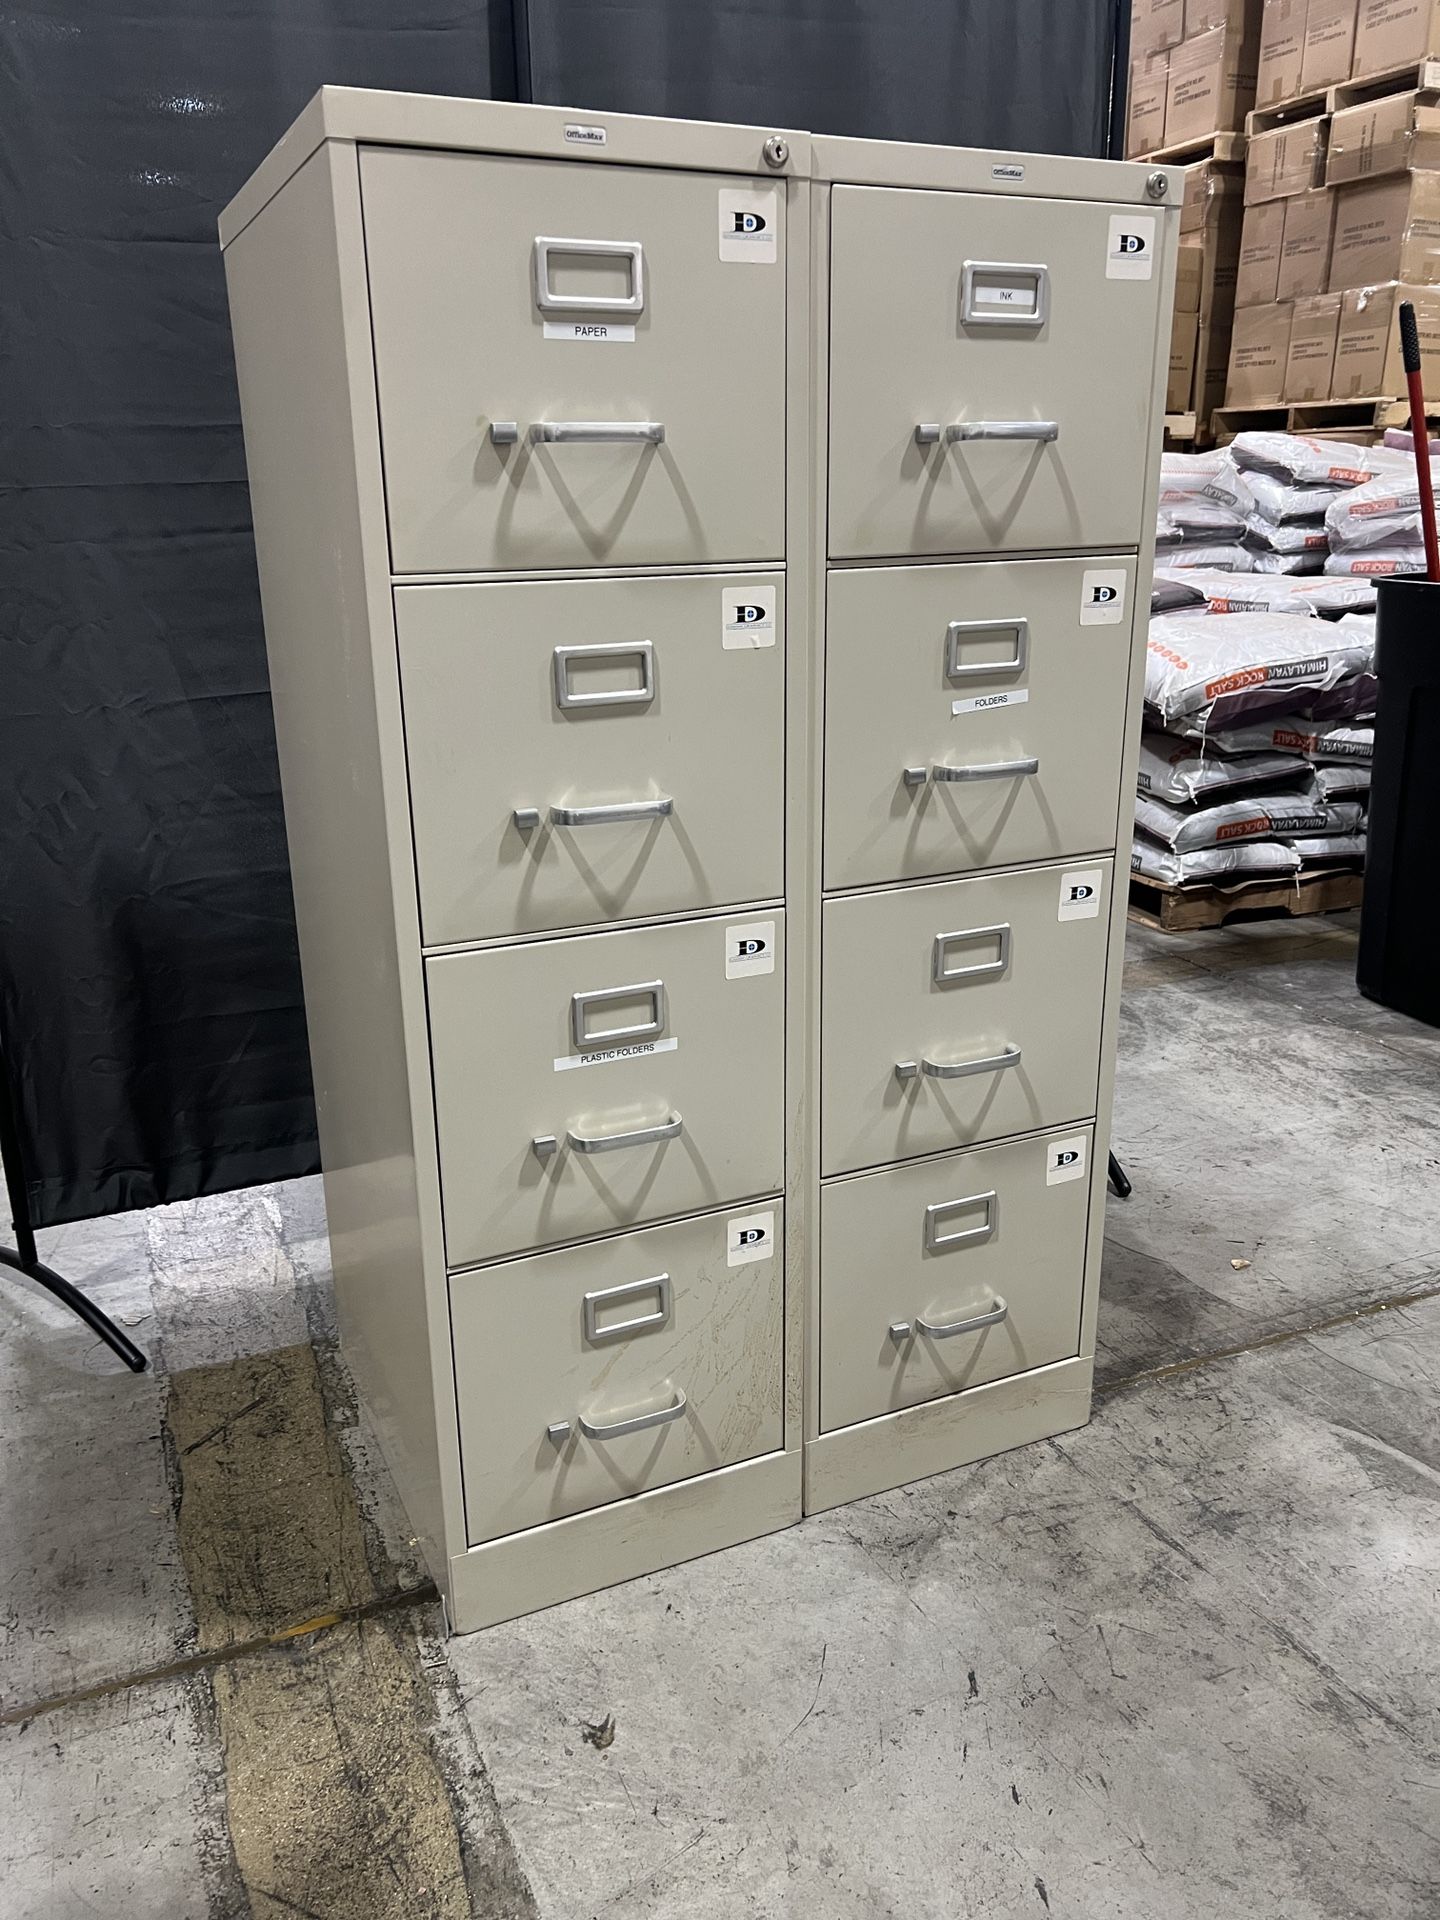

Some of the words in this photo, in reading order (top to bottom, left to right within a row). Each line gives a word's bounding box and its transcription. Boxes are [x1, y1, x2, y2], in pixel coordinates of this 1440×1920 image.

[1000, 291, 1013, 300] INK
[574, 326, 607, 337] PAPER
[1352, 562, 1372, 573] SALT
[1372, 562, 1395, 573] ROCK
[1268, 659, 1328, 680] HIMALAYAN
[1236, 670, 1266, 688] ROCK
[1209, 678, 1233, 697] SALT
[975, 695, 1008, 707] FOLDERS
[1317, 739, 1373, 756] HIMALAYAN
[1218, 824, 1243, 838] SALT
[1243, 817, 1269, 834] ROCK
[1271, 816, 1327, 831] HIMALAYAN
[581, 1050, 615, 1063] PLASTIC
[616, 1043, 655, 1057] FOLDERS
